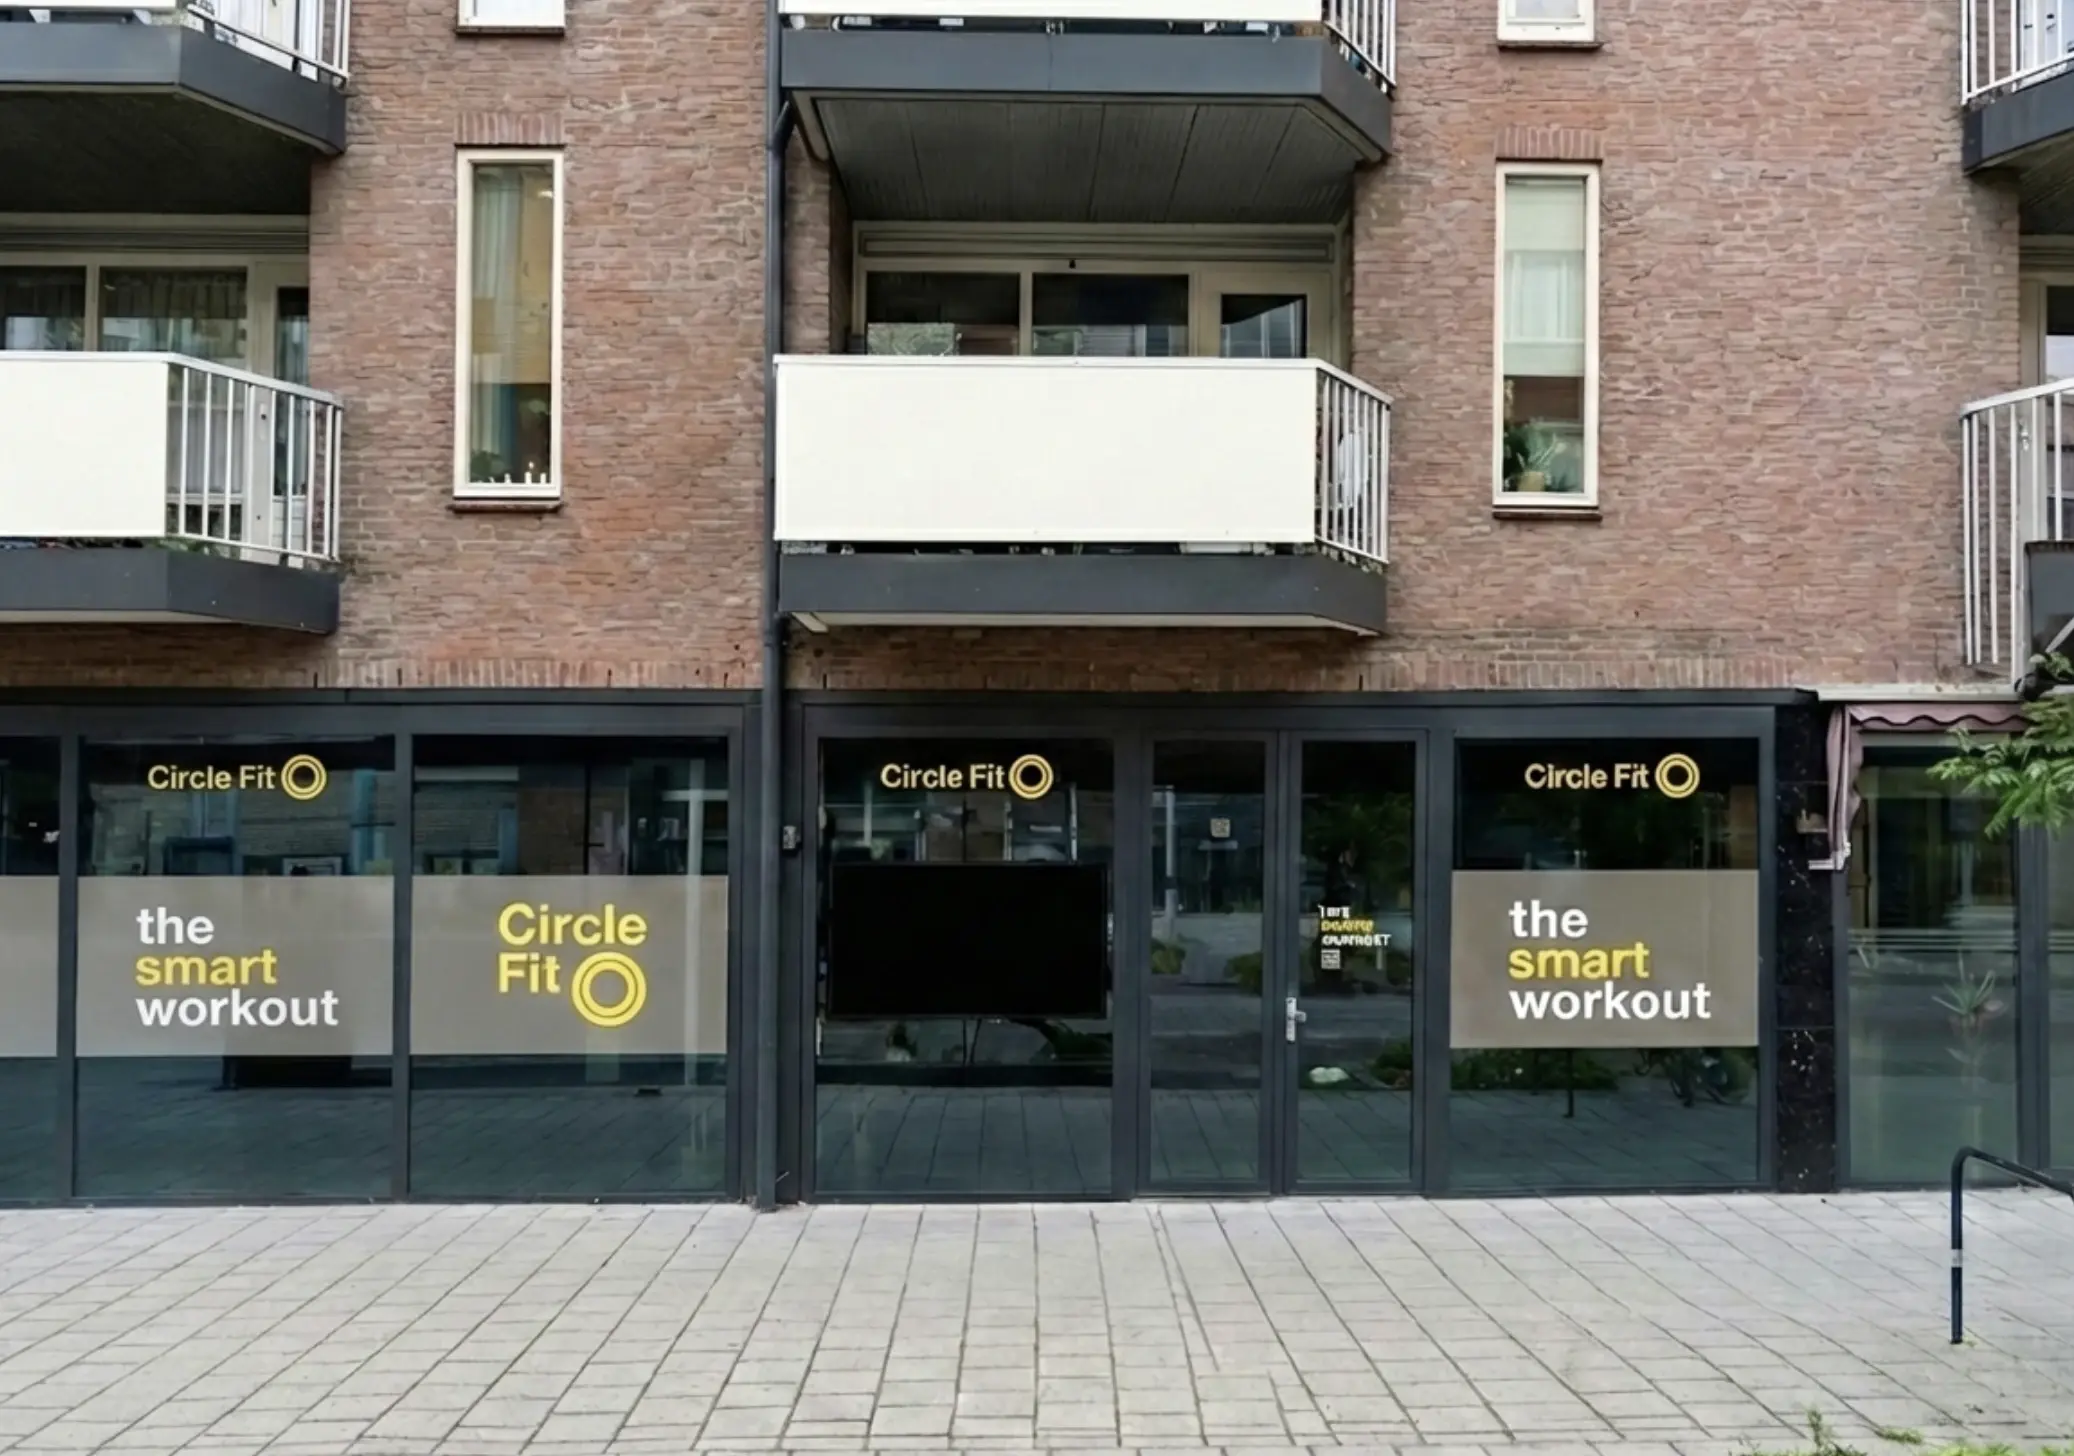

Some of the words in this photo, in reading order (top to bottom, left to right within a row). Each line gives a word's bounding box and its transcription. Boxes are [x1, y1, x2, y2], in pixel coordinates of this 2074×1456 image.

[149, 766, 231, 789] Circle
[240, 766, 275, 789] Fit
[881, 764, 962, 788] Circle
[971, 764, 1004, 788] Fit
[1525, 764, 1607, 788] Circle
[1615, 764, 1649, 788] Fit
[137, 907, 214, 944] the
[498, 903, 647, 946] Circle
[1509, 900, 1588, 938] the
[136, 949, 277, 986] smart
[498, 952, 561, 993] Fit
[1508, 942, 1649, 979] smart
[136, 989, 338, 1026] workout
[1509, 981, 1711, 1019] workout
